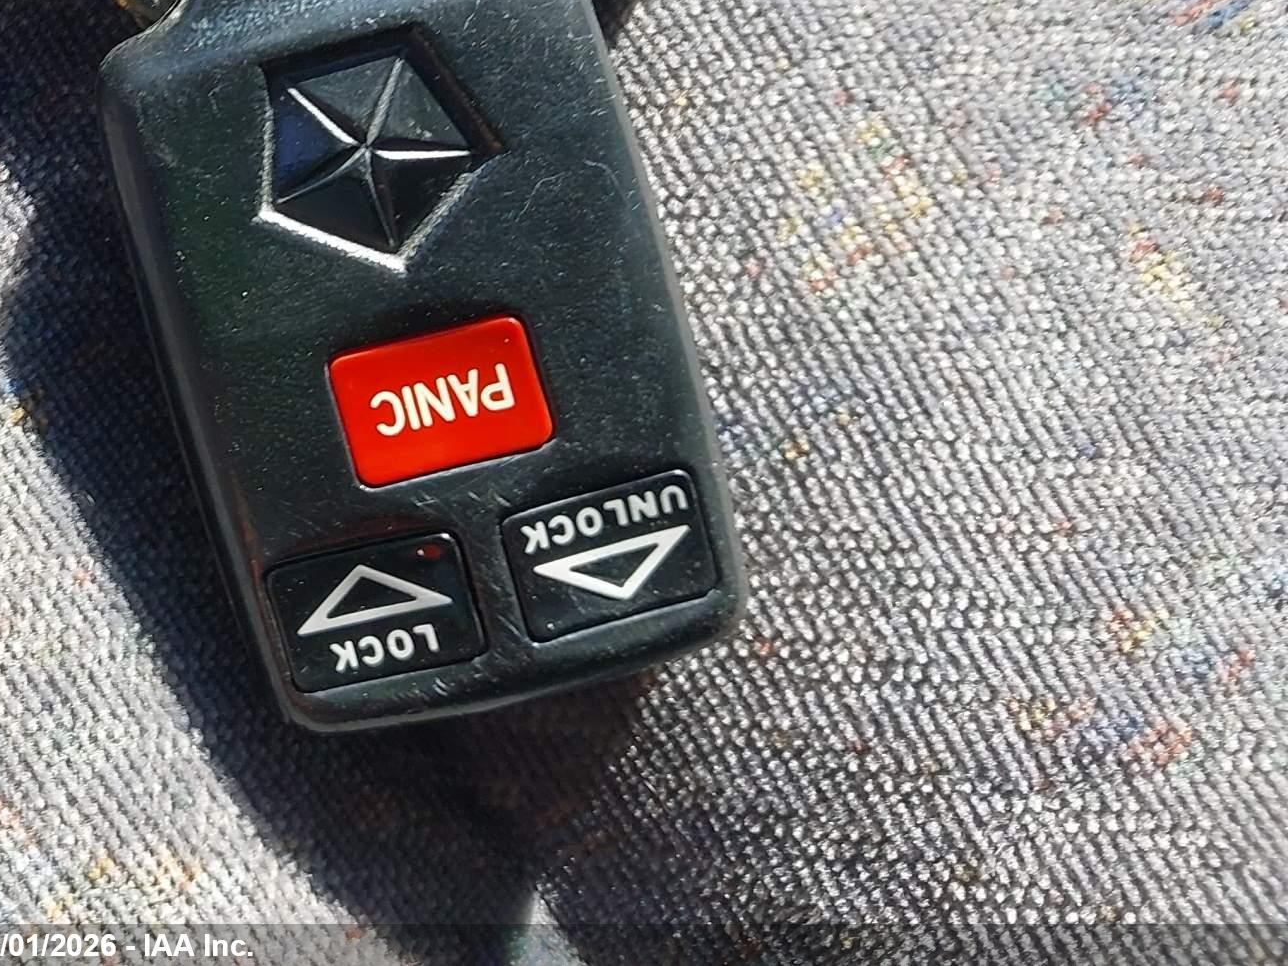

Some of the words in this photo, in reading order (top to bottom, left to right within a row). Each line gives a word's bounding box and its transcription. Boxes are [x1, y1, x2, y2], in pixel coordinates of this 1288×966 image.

[369, 362, 516, 436] PANIC
[520, 484, 689, 554] UNLOCK
[329, 623, 441, 673] LOCK
